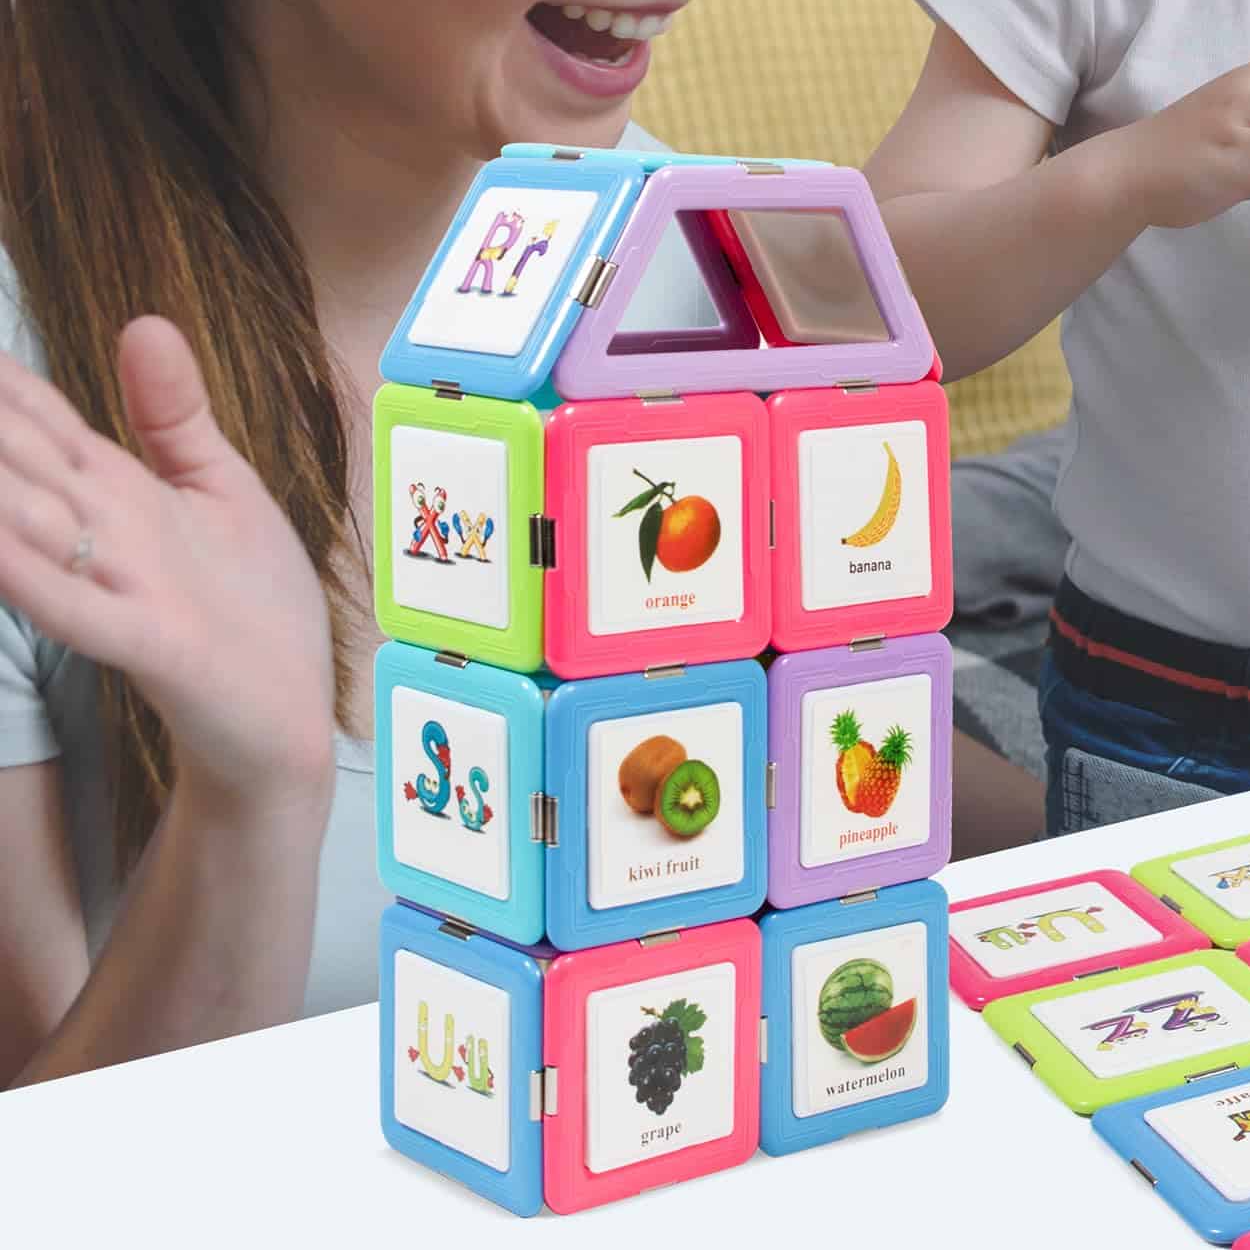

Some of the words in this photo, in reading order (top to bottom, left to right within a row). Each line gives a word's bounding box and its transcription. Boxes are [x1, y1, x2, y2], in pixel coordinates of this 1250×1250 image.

[848, 558, 892, 574] banana
[645, 593, 696, 609] orange
[839, 821, 899, 848] pineapple
[628, 858, 661, 881] kiwi
[666, 855, 701, 874] fruit
[825, 1064, 906, 1096] watermelon
[640, 1121, 682, 1146] grape
